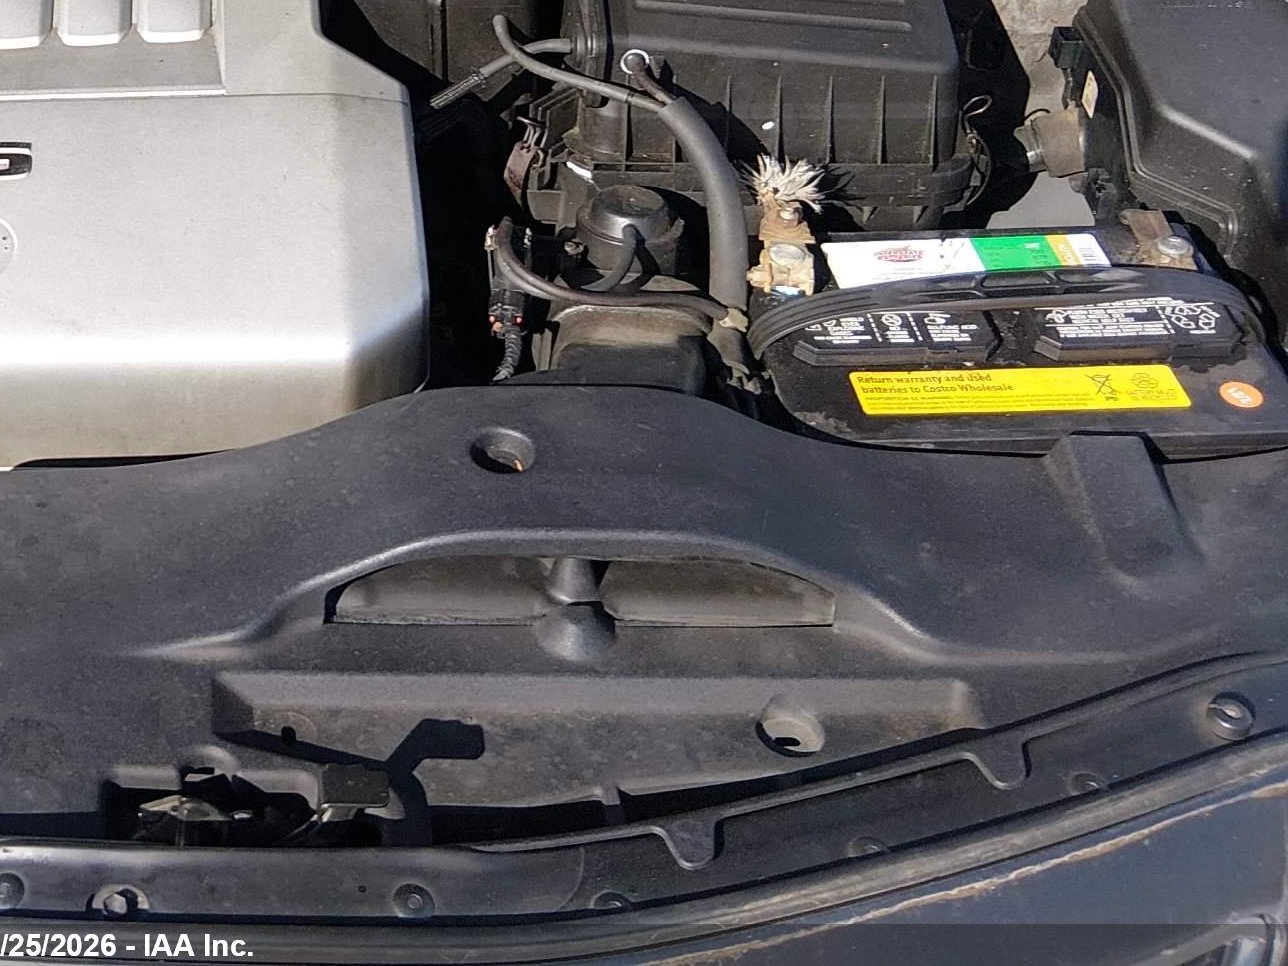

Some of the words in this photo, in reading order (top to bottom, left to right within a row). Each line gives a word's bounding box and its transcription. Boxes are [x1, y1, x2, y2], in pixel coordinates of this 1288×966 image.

[857, 376, 894, 385] Return
[895, 375, 942, 385] warranty
[945, 374, 965, 383] and
[862, 385, 908, 395] batteries
[911, 385, 921, 394] to
[923, 385, 958, 394] Costco
[959, 383, 1015, 393] Wholesale
